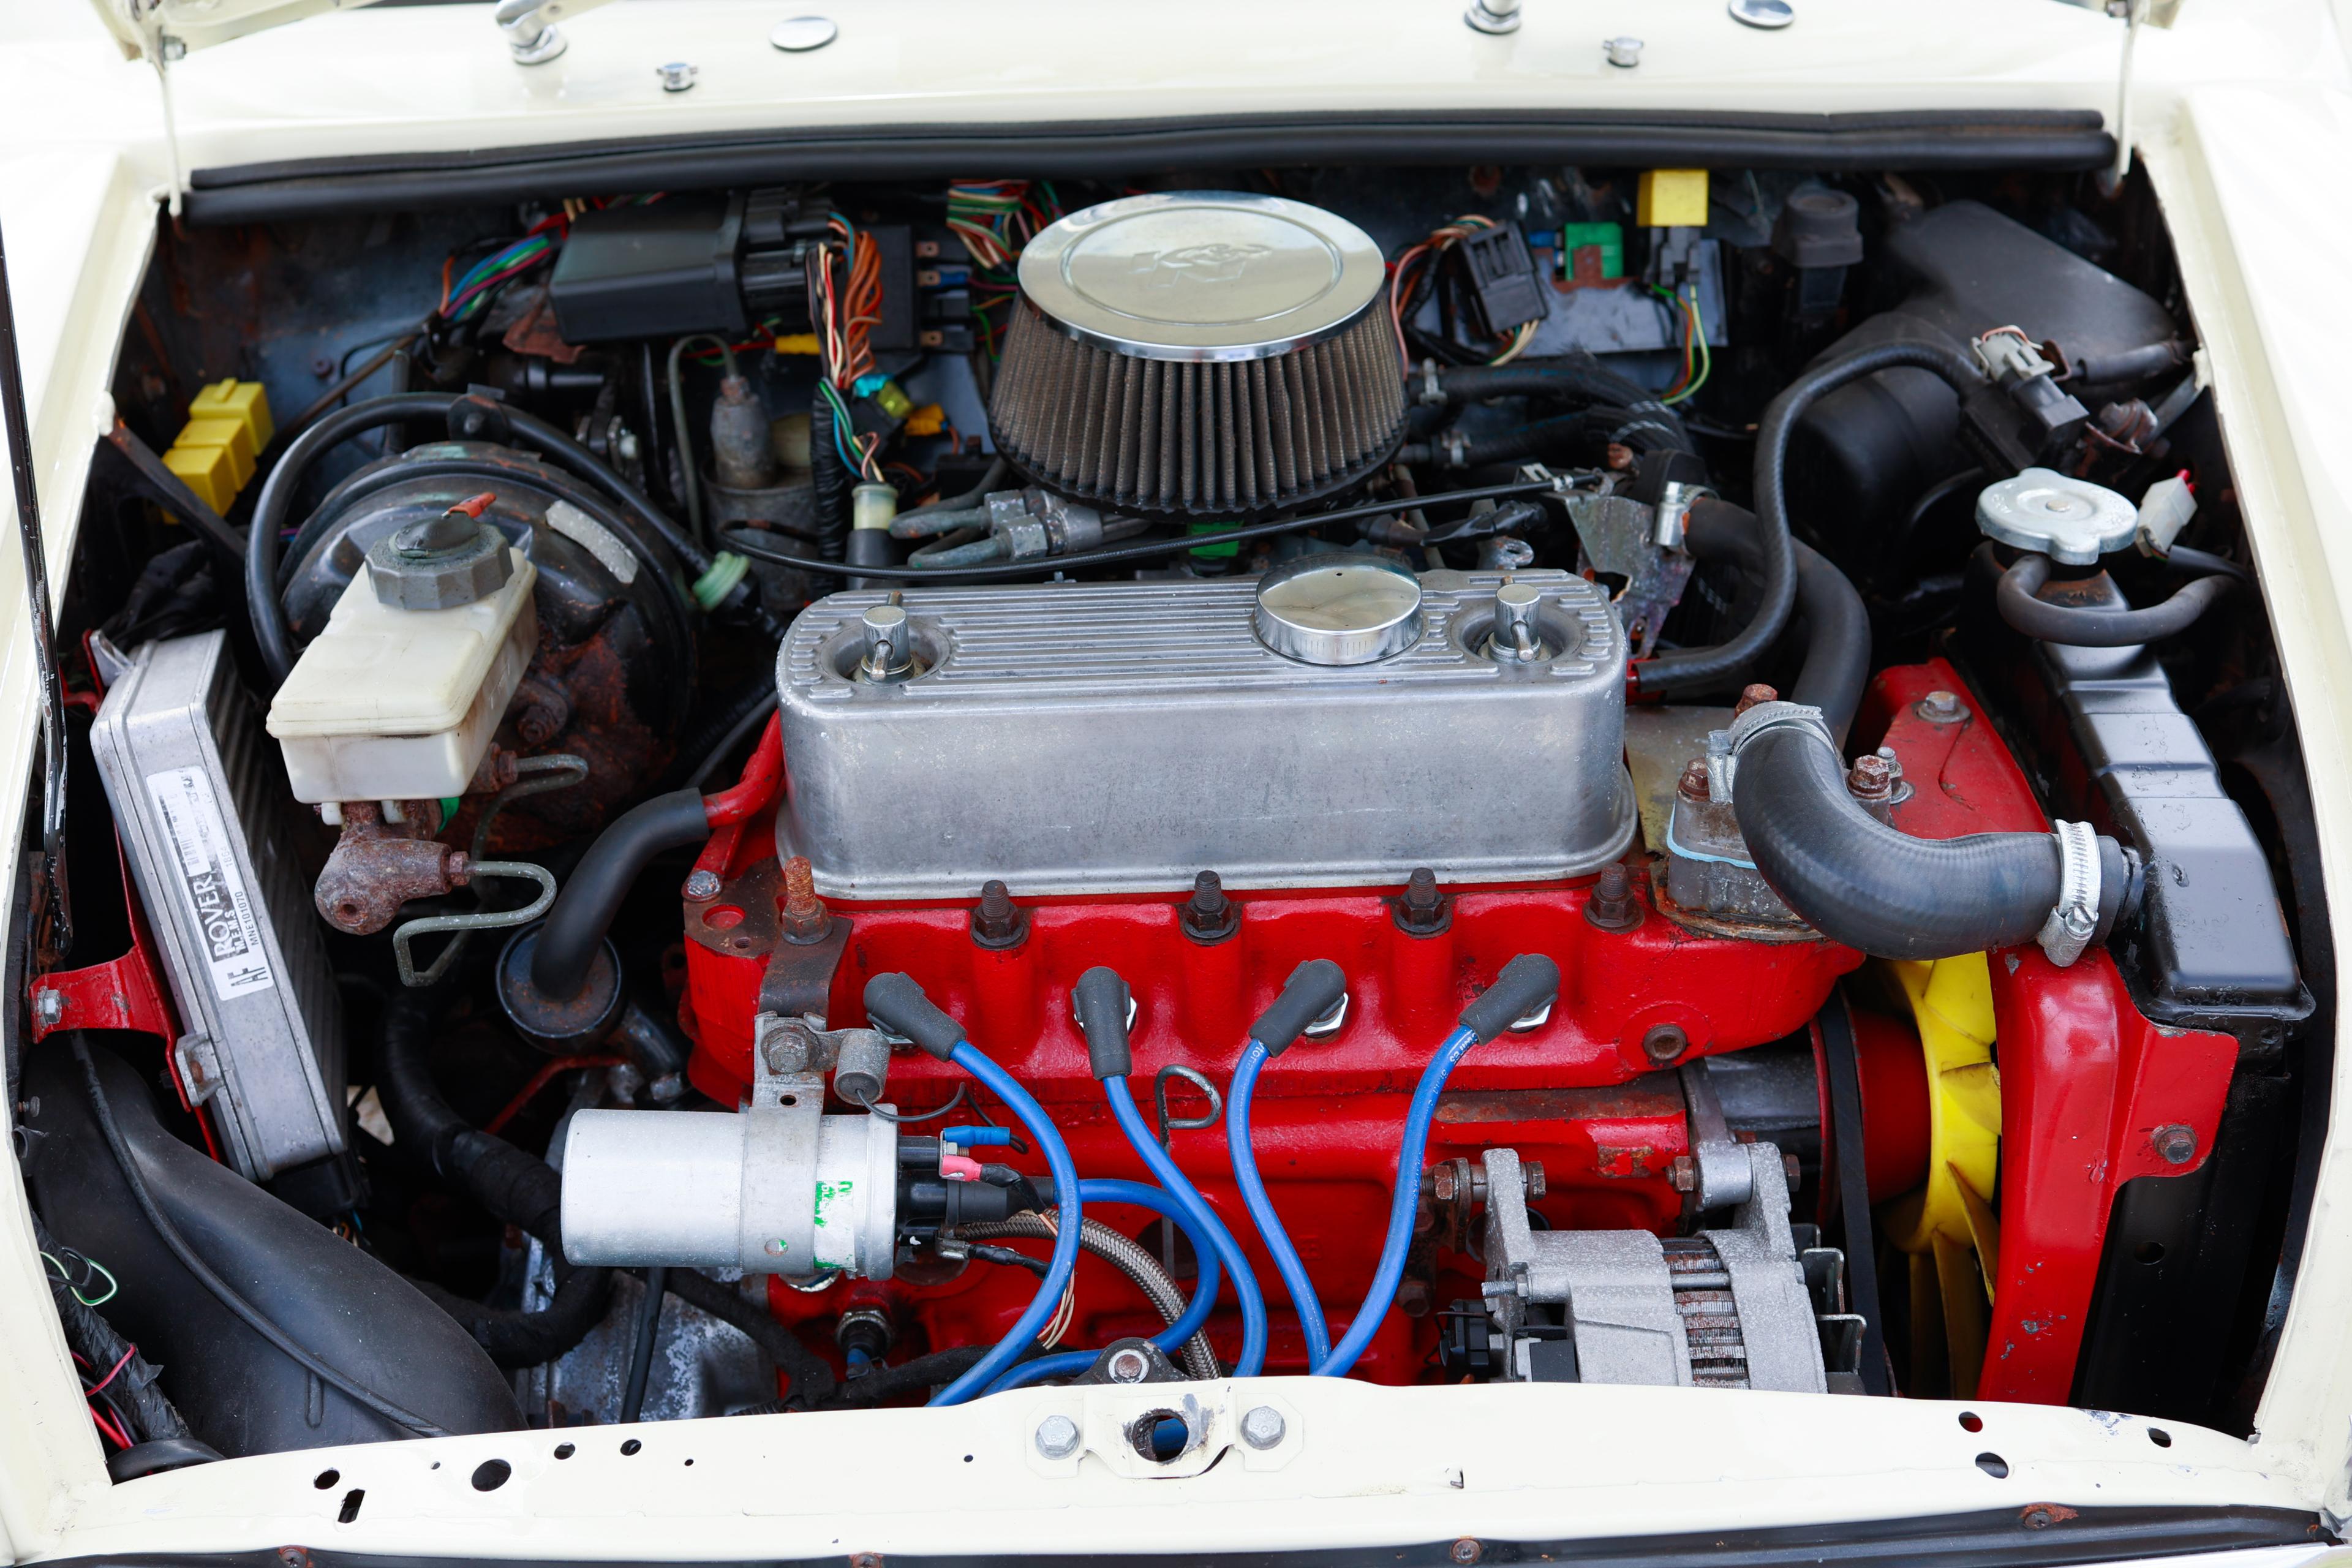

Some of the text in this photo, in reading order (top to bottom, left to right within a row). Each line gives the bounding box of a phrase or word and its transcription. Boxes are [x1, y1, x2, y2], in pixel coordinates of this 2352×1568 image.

[193, 874, 236, 957] ROVER
[235, 891, 259, 946] MNE101070
[227, 967, 268, 987] AF
